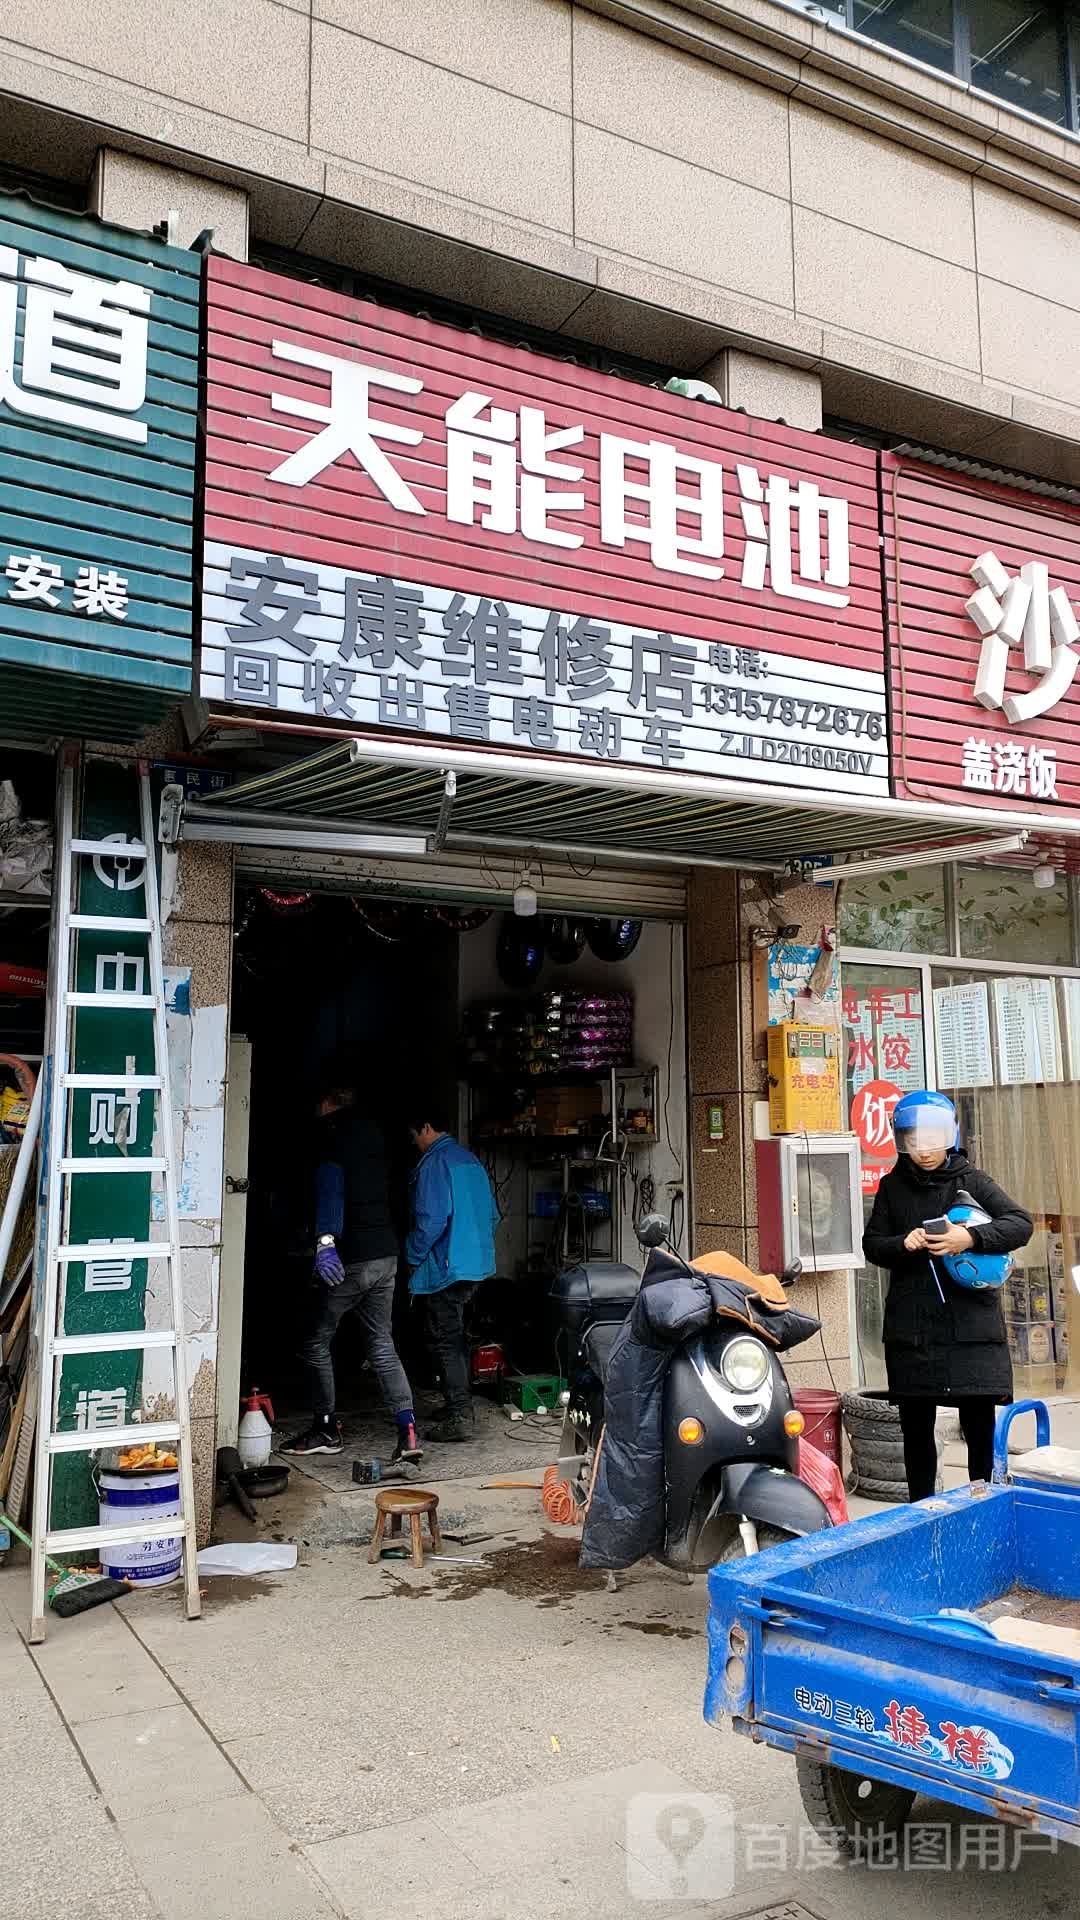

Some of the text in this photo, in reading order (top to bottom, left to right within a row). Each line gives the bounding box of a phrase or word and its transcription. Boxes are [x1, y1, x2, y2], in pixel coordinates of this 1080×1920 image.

[0, 246, 152, 445] 道
[265, 338, 850, 609] 天能电池
[5, 553, 129, 620] 安装
[224, 555, 698, 718] 安康维修店
[964, 550, 1080, 725] 沙
[224, 645, 686, 766] 回收出售电动车
[700, 682, 882, 741] 13157872676
[719, 733, 874, 775] ZJLD2019050V
[961, 736, 1059, 799] 盖浇饭
[791, 1073, 835, 1089] 充电站
[847, 1032, 911, 1070] 水饺
[794, 1685, 993, 1773] 电动三轮 捷祥
